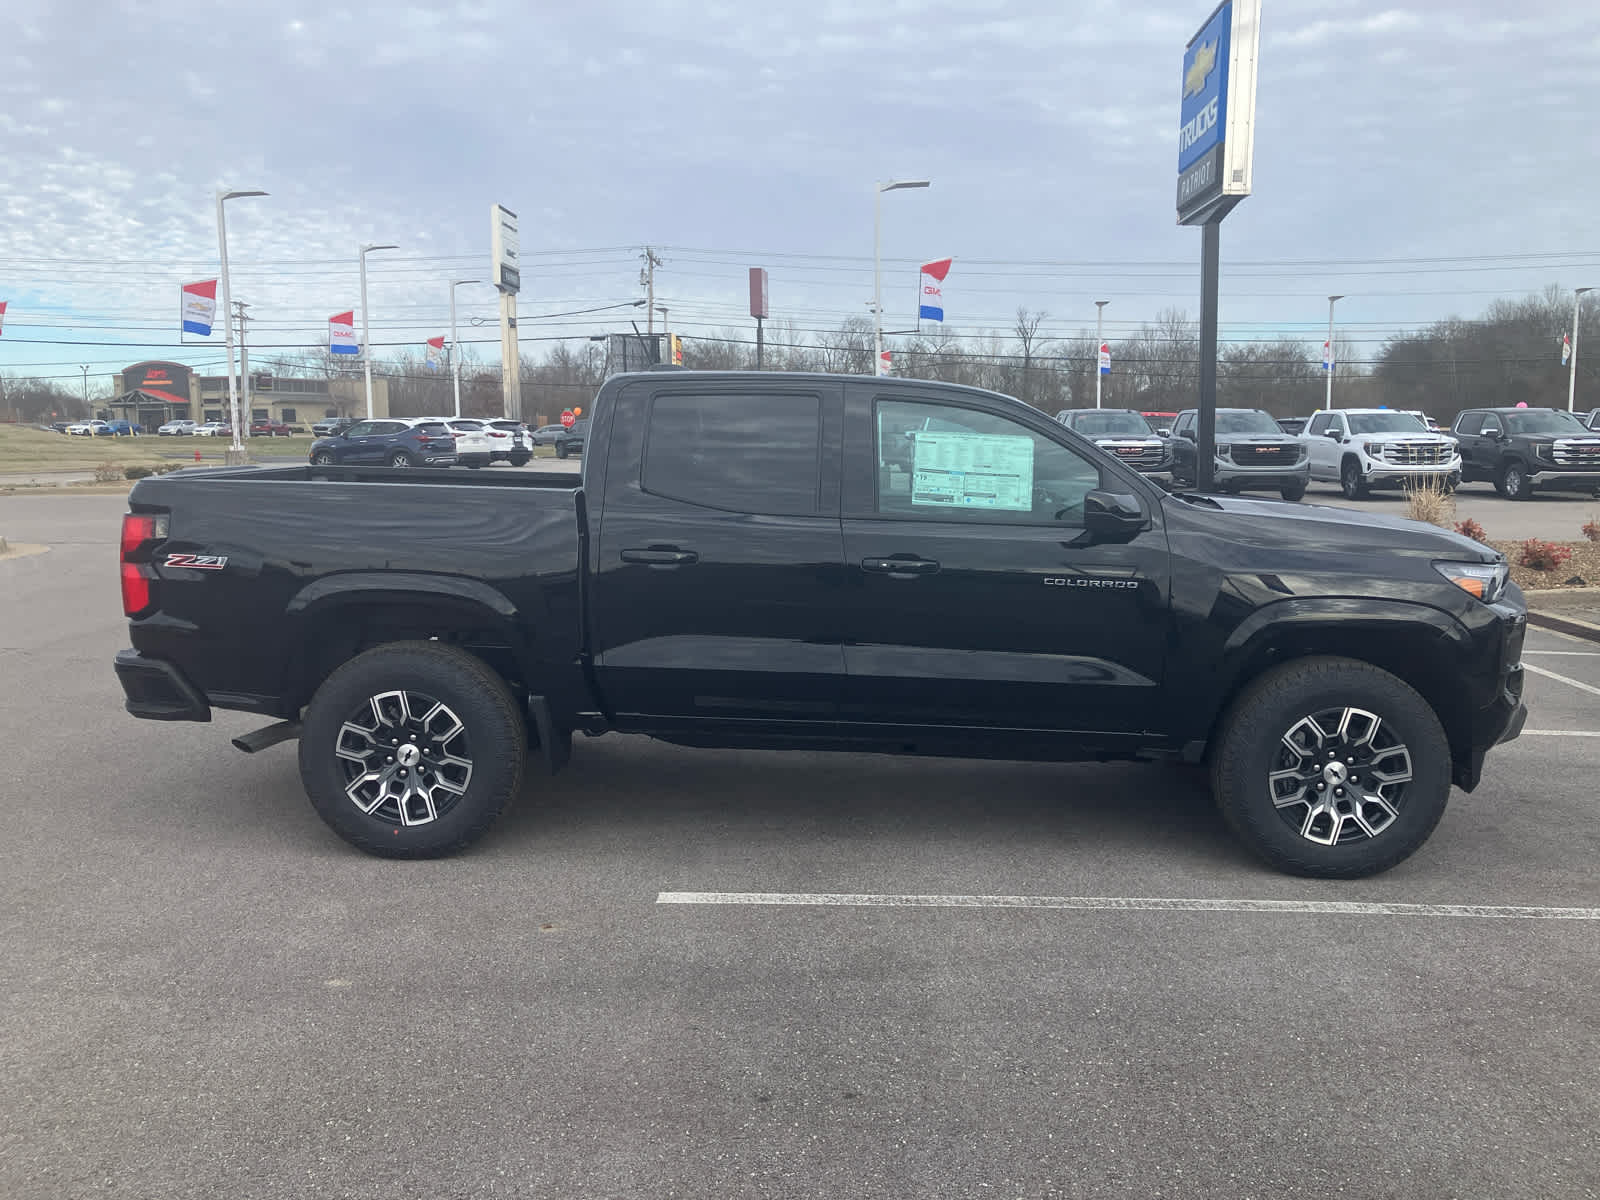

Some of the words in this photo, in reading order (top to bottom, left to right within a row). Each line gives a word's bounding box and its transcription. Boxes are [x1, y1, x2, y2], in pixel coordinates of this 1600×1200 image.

[1179, 96, 1218, 152] TRUCKS
[1181, 161, 1212, 195] PATRIOT
[163, 553, 229, 570] Z71
[1044, 578, 1138, 589] COLORADO
